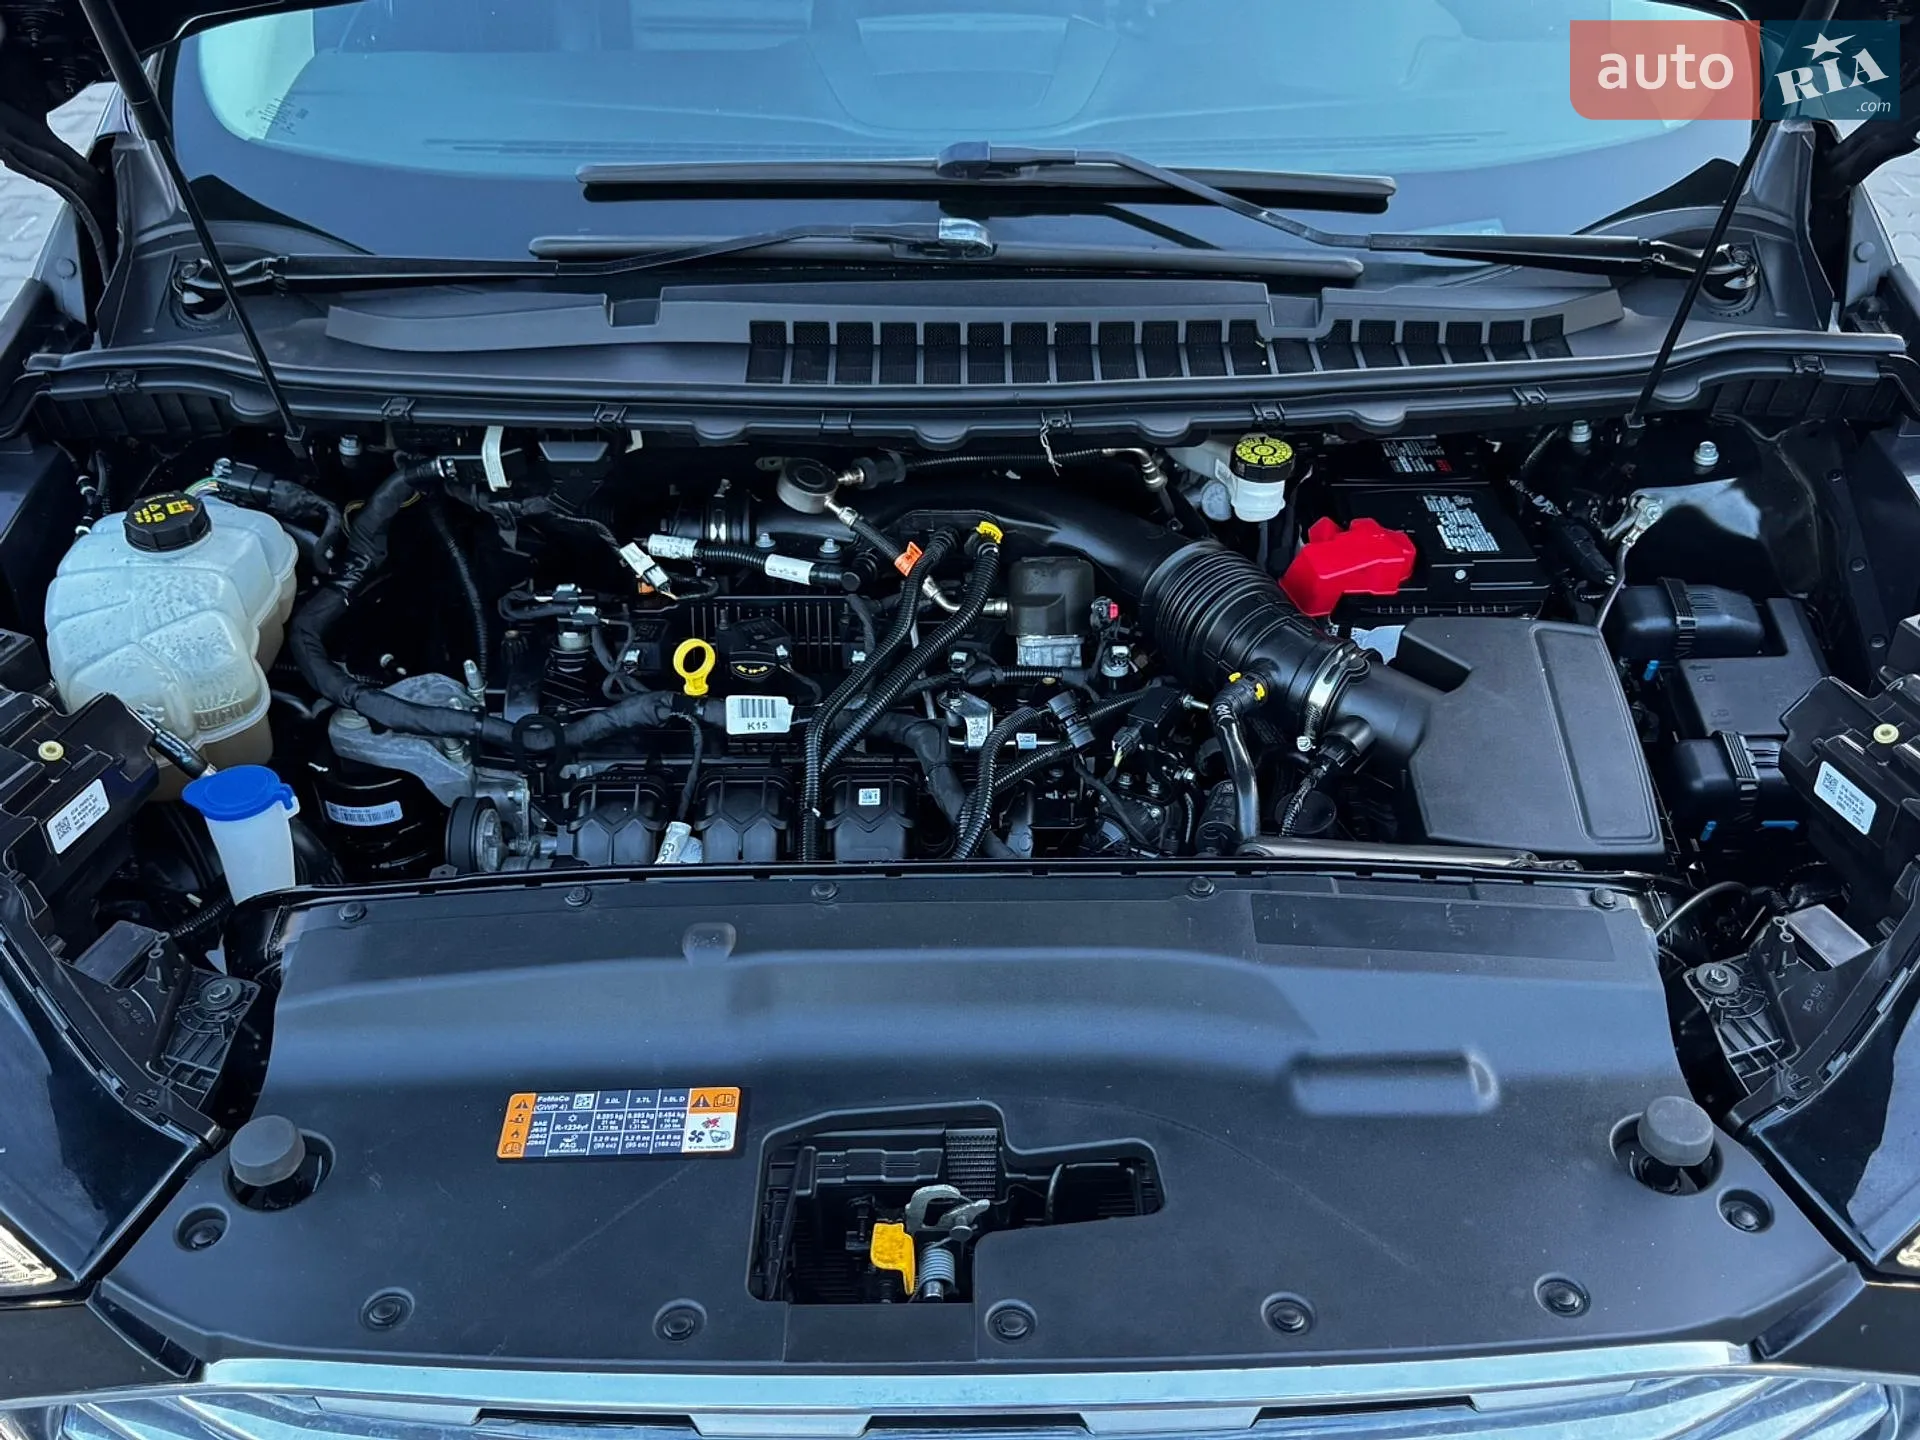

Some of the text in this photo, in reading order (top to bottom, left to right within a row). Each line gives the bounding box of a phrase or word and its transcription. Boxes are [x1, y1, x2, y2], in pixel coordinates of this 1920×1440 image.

[747, 721, 768, 730] K15
[635, 1096, 652, 1104] 2.7L
[554, 1124, 589, 1132] R-1234yf
